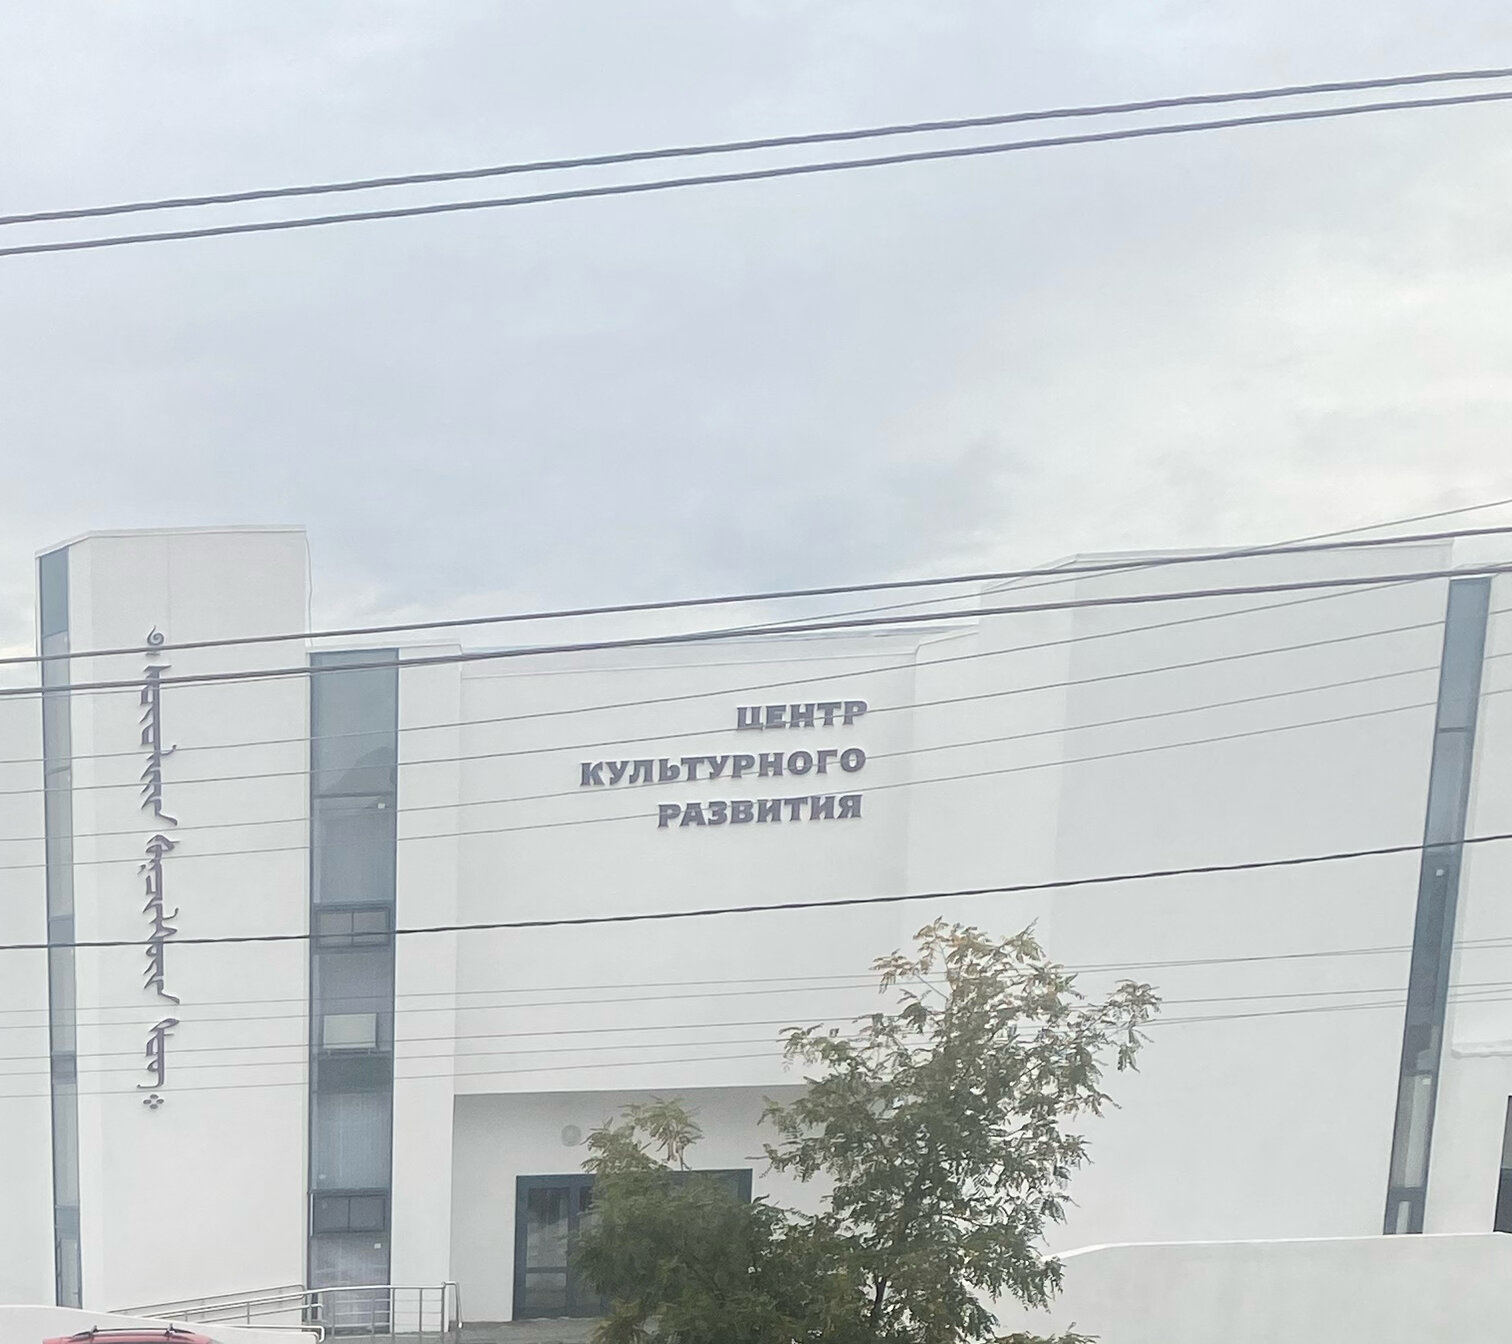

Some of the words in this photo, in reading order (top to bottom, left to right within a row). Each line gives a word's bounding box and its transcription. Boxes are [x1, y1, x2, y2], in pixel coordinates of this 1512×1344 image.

[736, 700, 868, 731] ЦЕНТР
[580, 747, 867, 787] КУЛЬТУРНОГО
[657, 794, 864, 828] РАЗВИТИЯ
